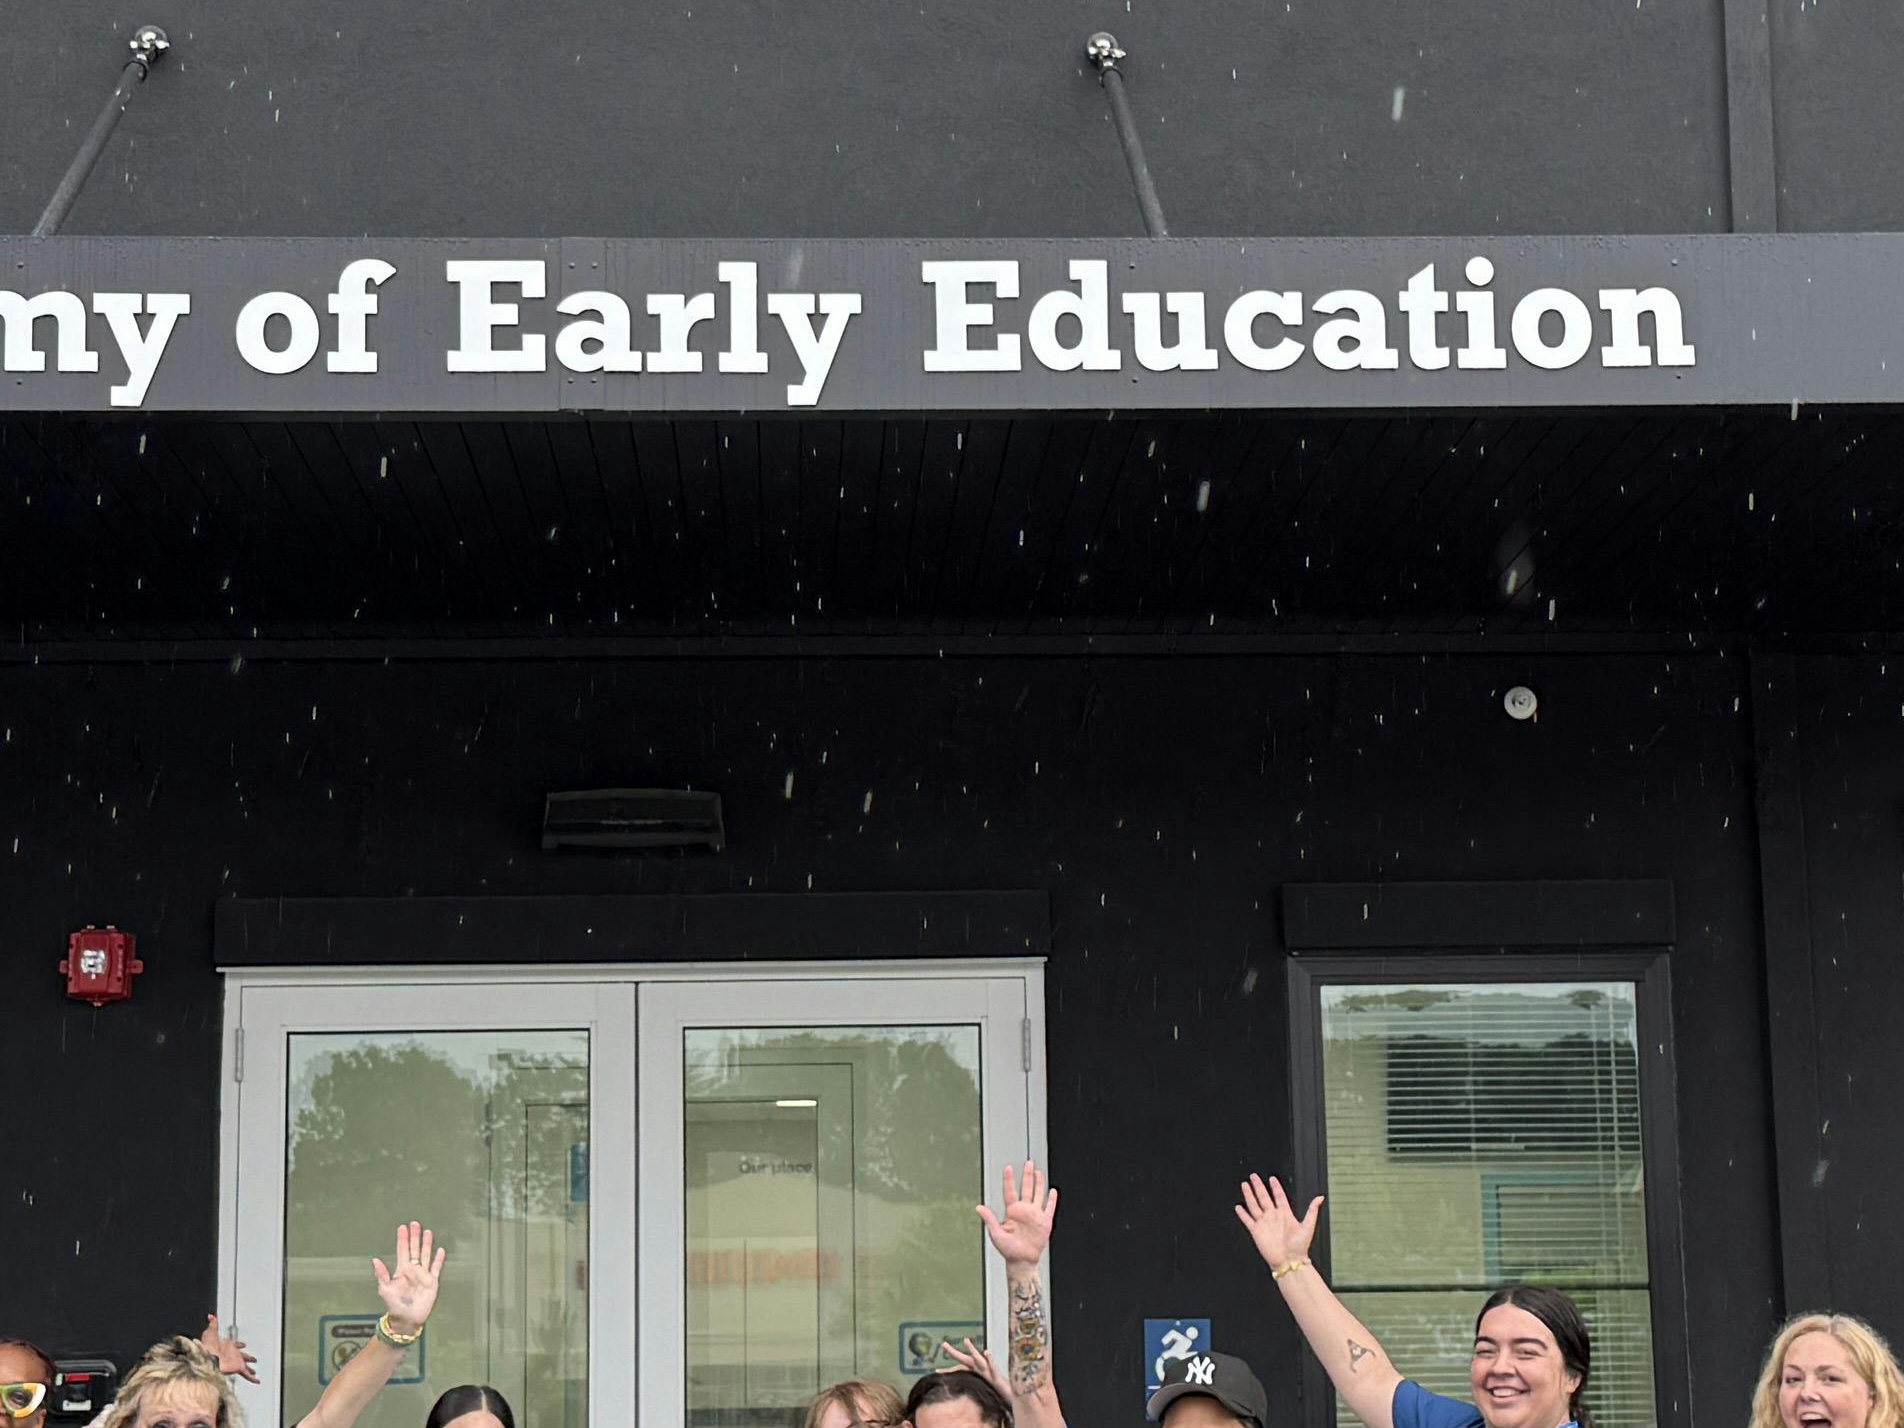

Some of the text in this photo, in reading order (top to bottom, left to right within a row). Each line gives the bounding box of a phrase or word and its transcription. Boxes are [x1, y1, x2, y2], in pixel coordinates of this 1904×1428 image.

[234, 258, 397, 374] of
[445, 259, 863, 407] Early
[921, 254, 1697, 374] Education
[1184, 1355, 1216, 1386] NY
